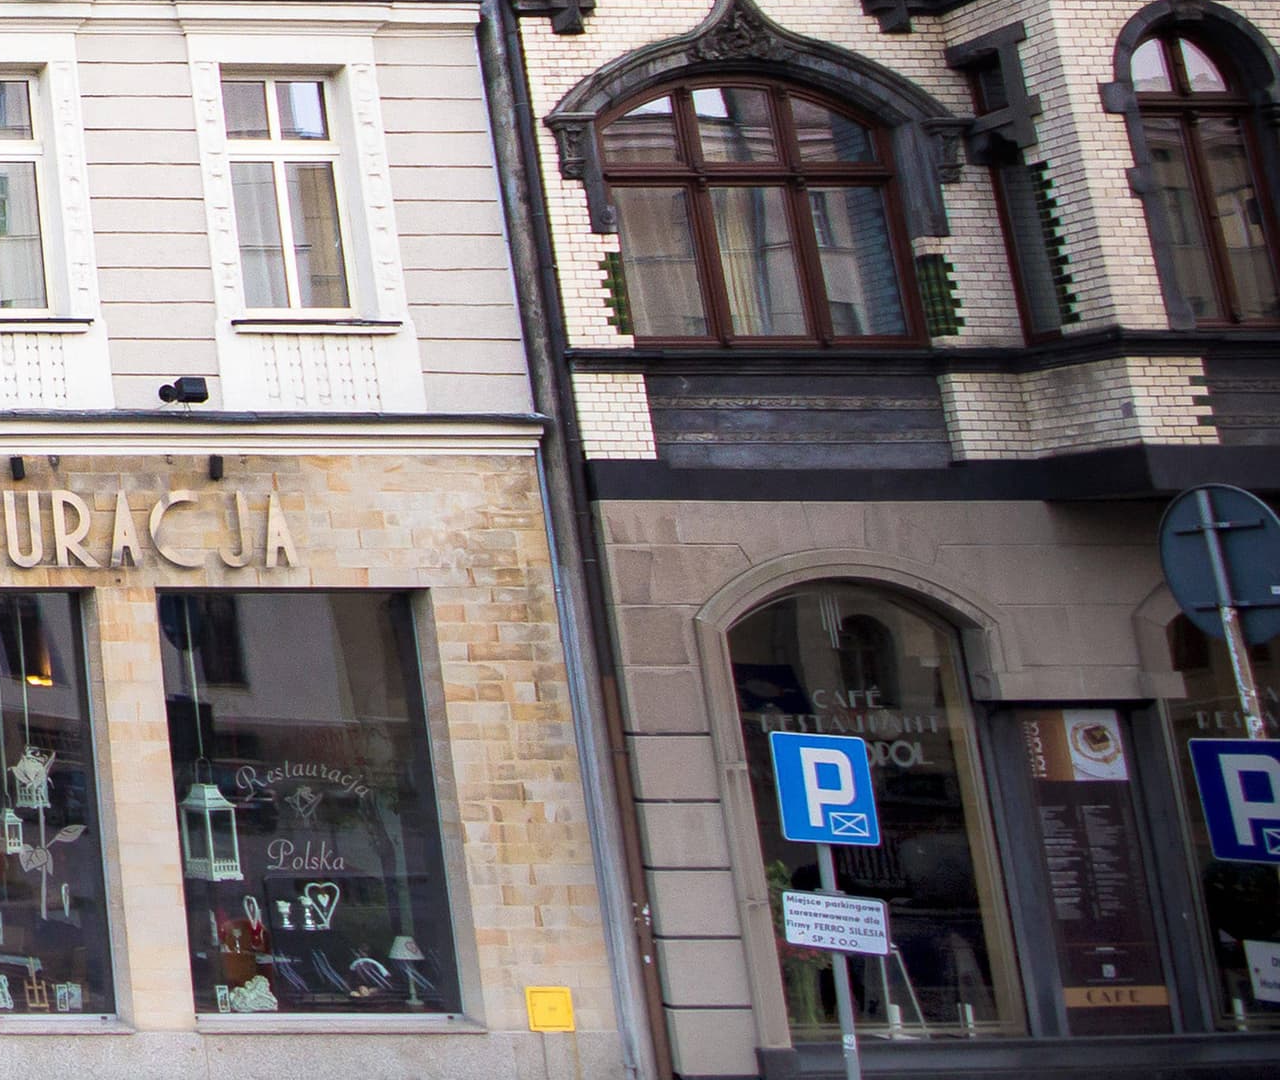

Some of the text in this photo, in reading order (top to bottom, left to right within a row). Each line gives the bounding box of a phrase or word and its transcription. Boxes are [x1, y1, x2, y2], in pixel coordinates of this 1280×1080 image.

[236, 760, 371, 801] Restauracja
[799, 747, 856, 827] P
[1218, 754, 1280, 846] P
[267, 839, 345, 870] Polska
[786, 895, 880, 912] Miejsce parkingowe
[814, 922, 845, 933] FERRO
[849, 927, 884, 937] SILESIA
[864, 916, 880, 925] dla
